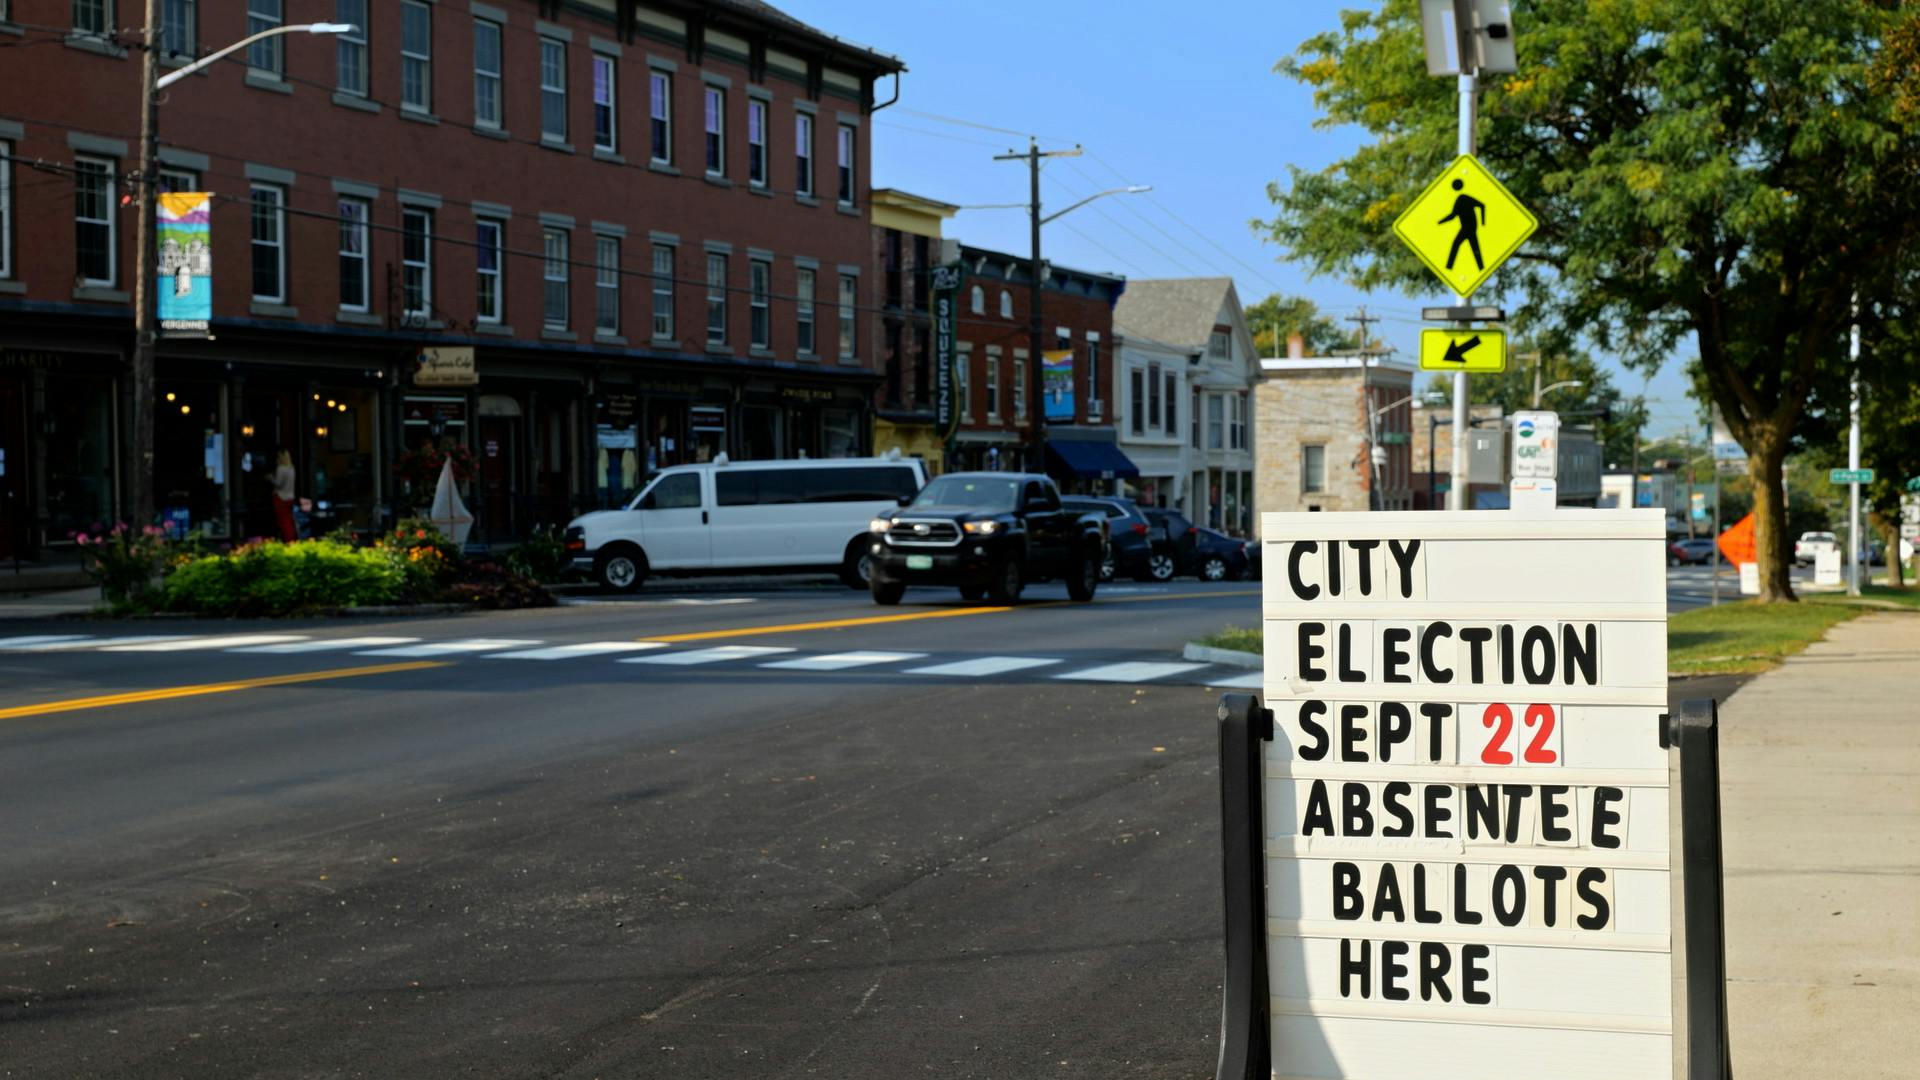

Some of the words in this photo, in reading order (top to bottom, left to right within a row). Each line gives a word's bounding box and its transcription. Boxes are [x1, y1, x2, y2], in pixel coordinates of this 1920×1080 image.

[160, 319, 209, 330] VERGENNES
[938, 299, 951, 425] SQUEEZE
[1287, 540, 1421, 600] CITY
[1298, 621, 1597, 685] ELECTION
[1298, 700, 1452, 762] SEPT
[1481, 703, 1557, 765] 22
[1302, 779, 1623, 849] ABSENTEE
[1332, 861, 1610, 930] BALLOTS
[1340, 938, 1491, 1004] HERE
